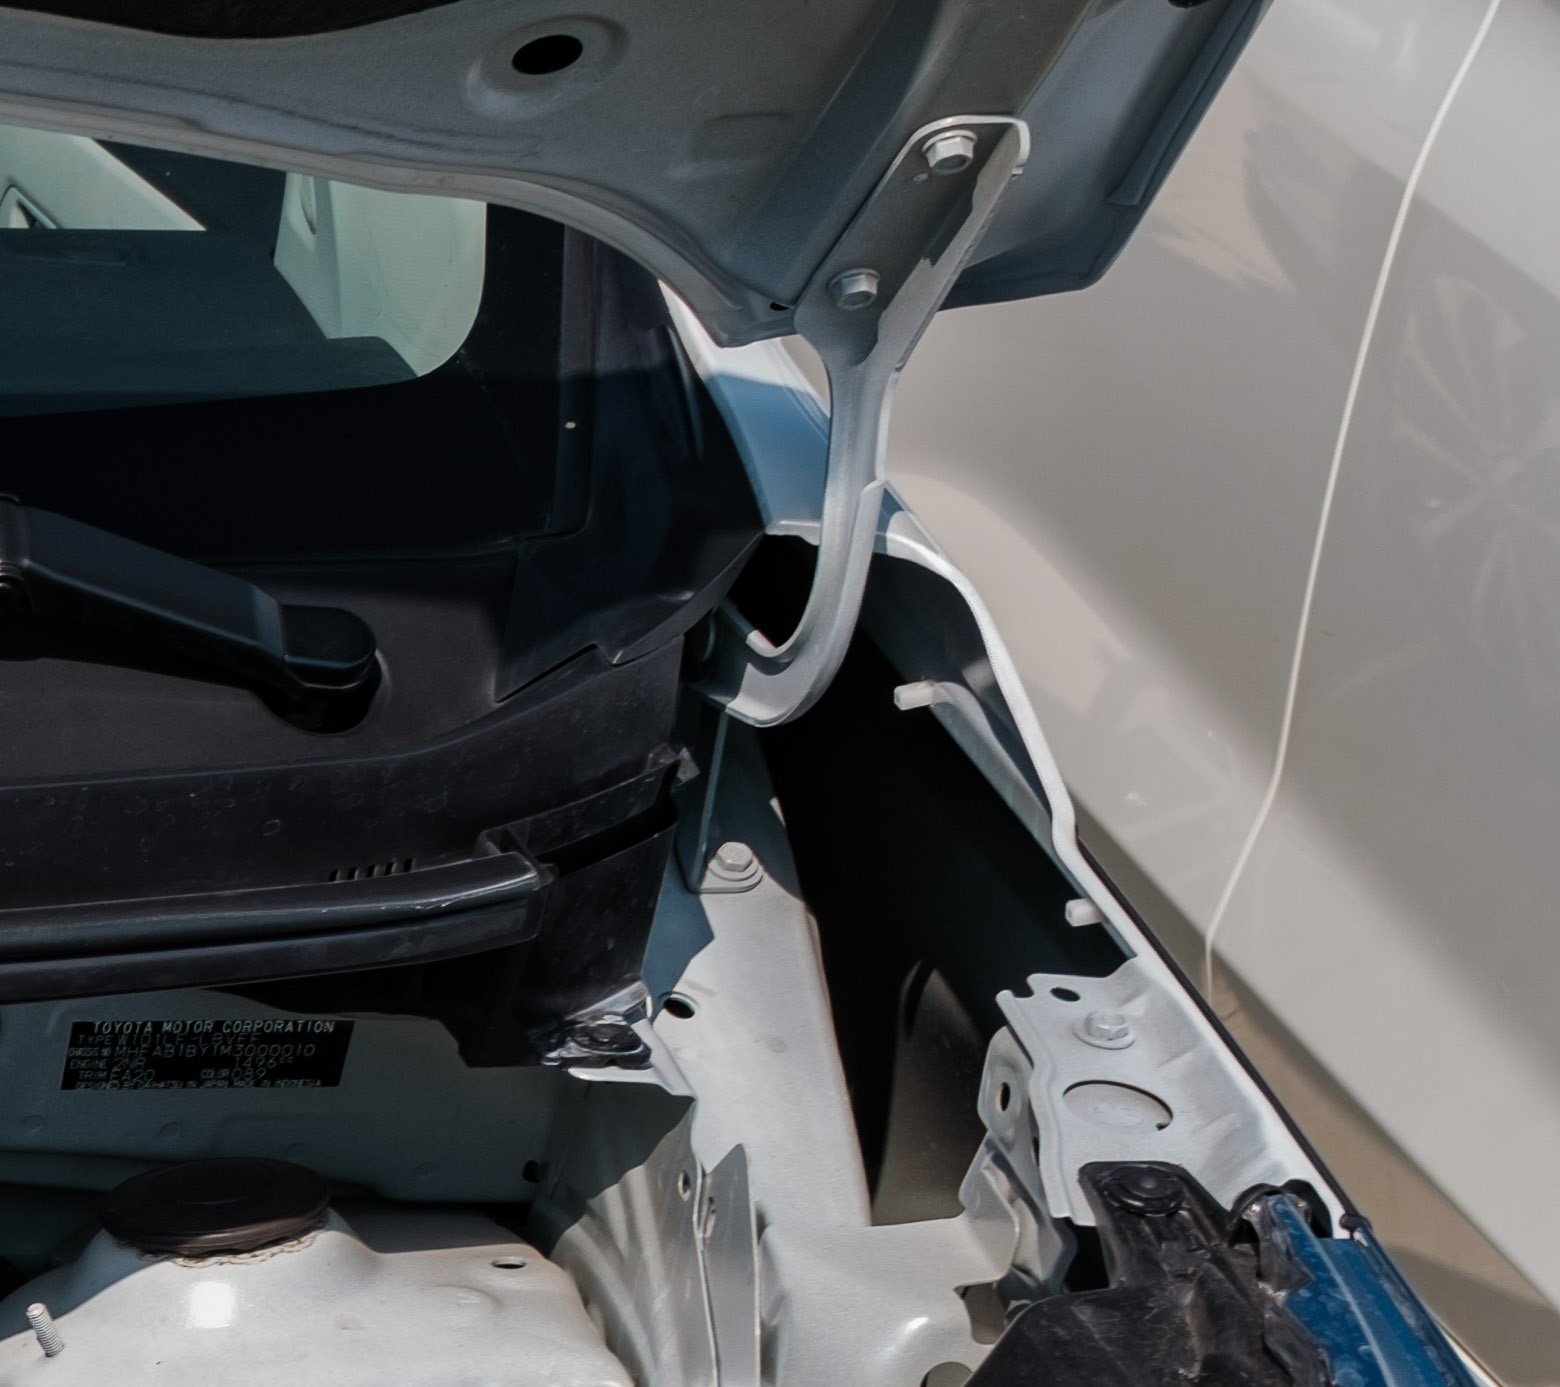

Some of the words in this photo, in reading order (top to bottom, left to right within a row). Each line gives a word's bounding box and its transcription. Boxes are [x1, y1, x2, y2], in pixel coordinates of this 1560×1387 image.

[93, 1020, 152, 1034] TOYOTA
[162, 1020, 214, 1034] MOTOR
[222, 1020, 337, 1033] CORPORATION
[78, 1034, 113, 1045] TYPE
